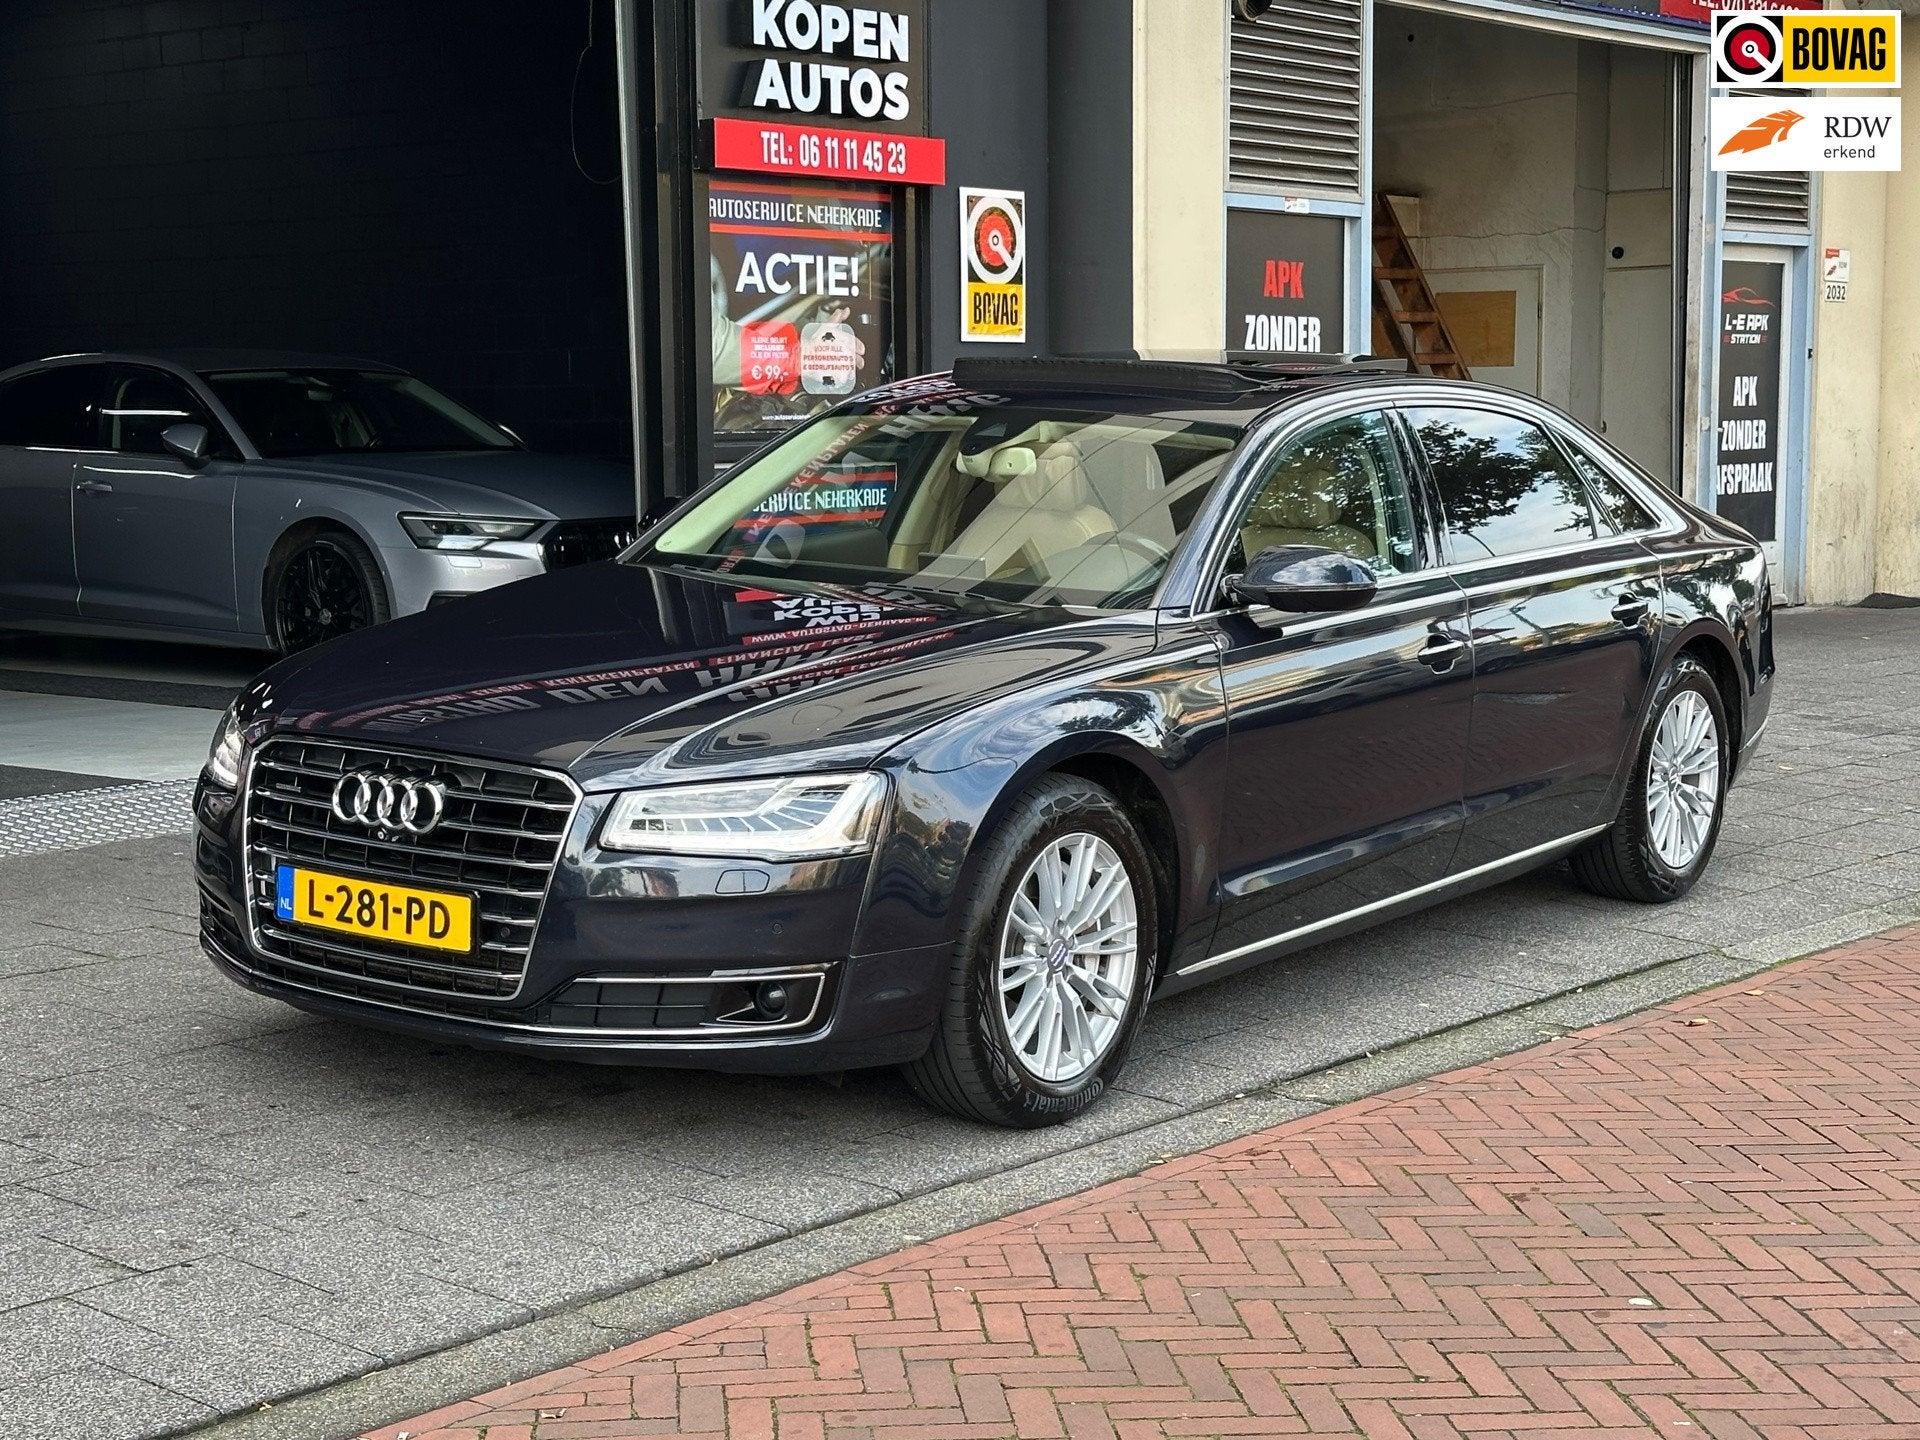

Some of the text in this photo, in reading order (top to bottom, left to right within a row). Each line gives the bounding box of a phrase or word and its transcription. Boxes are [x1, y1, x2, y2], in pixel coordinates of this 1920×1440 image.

[752, 0, 909, 63] KOPEN
[753, 58, 910, 121] AUTOS
[760, 131, 907, 175] TEL: 06 11 11 45 23
[709, 197, 883, 228] AUTOSERVICE NEHERKADE
[736, 251, 860, 297] ACTIE!
[1263, 259, 1305, 299] APK
[973, 291, 1019, 327] BOVAG
[1826, 285, 1846, 300] 2032
[1244, 314, 1321, 353] ZONDER
[1730, 333, 1761, 344] STATION
[1733, 375, 1758, 407] APK
[1721, 419, 1767, 451] ZONDER
[815, 488, 887, 510] NEHERKADE
[280, 897, 292, 911] NL
[308, 878, 451, 940] L-281-PD
